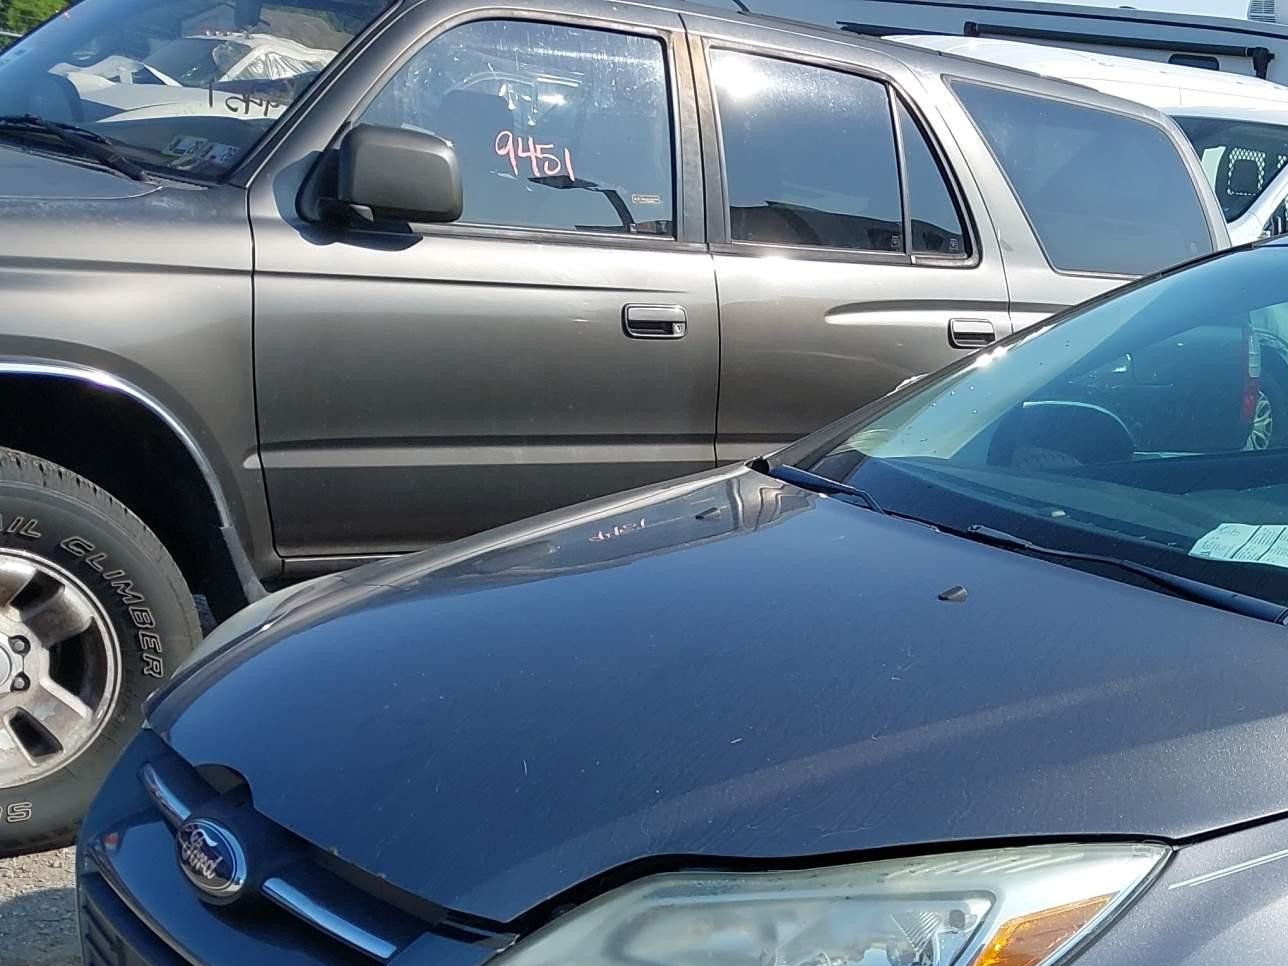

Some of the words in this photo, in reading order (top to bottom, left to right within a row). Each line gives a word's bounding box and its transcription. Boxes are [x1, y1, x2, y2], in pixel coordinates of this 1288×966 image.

[495, 130, 575, 182] 9451
[0, 513, 42, 539] IL
[60, 536, 164, 678] CLIMBER
